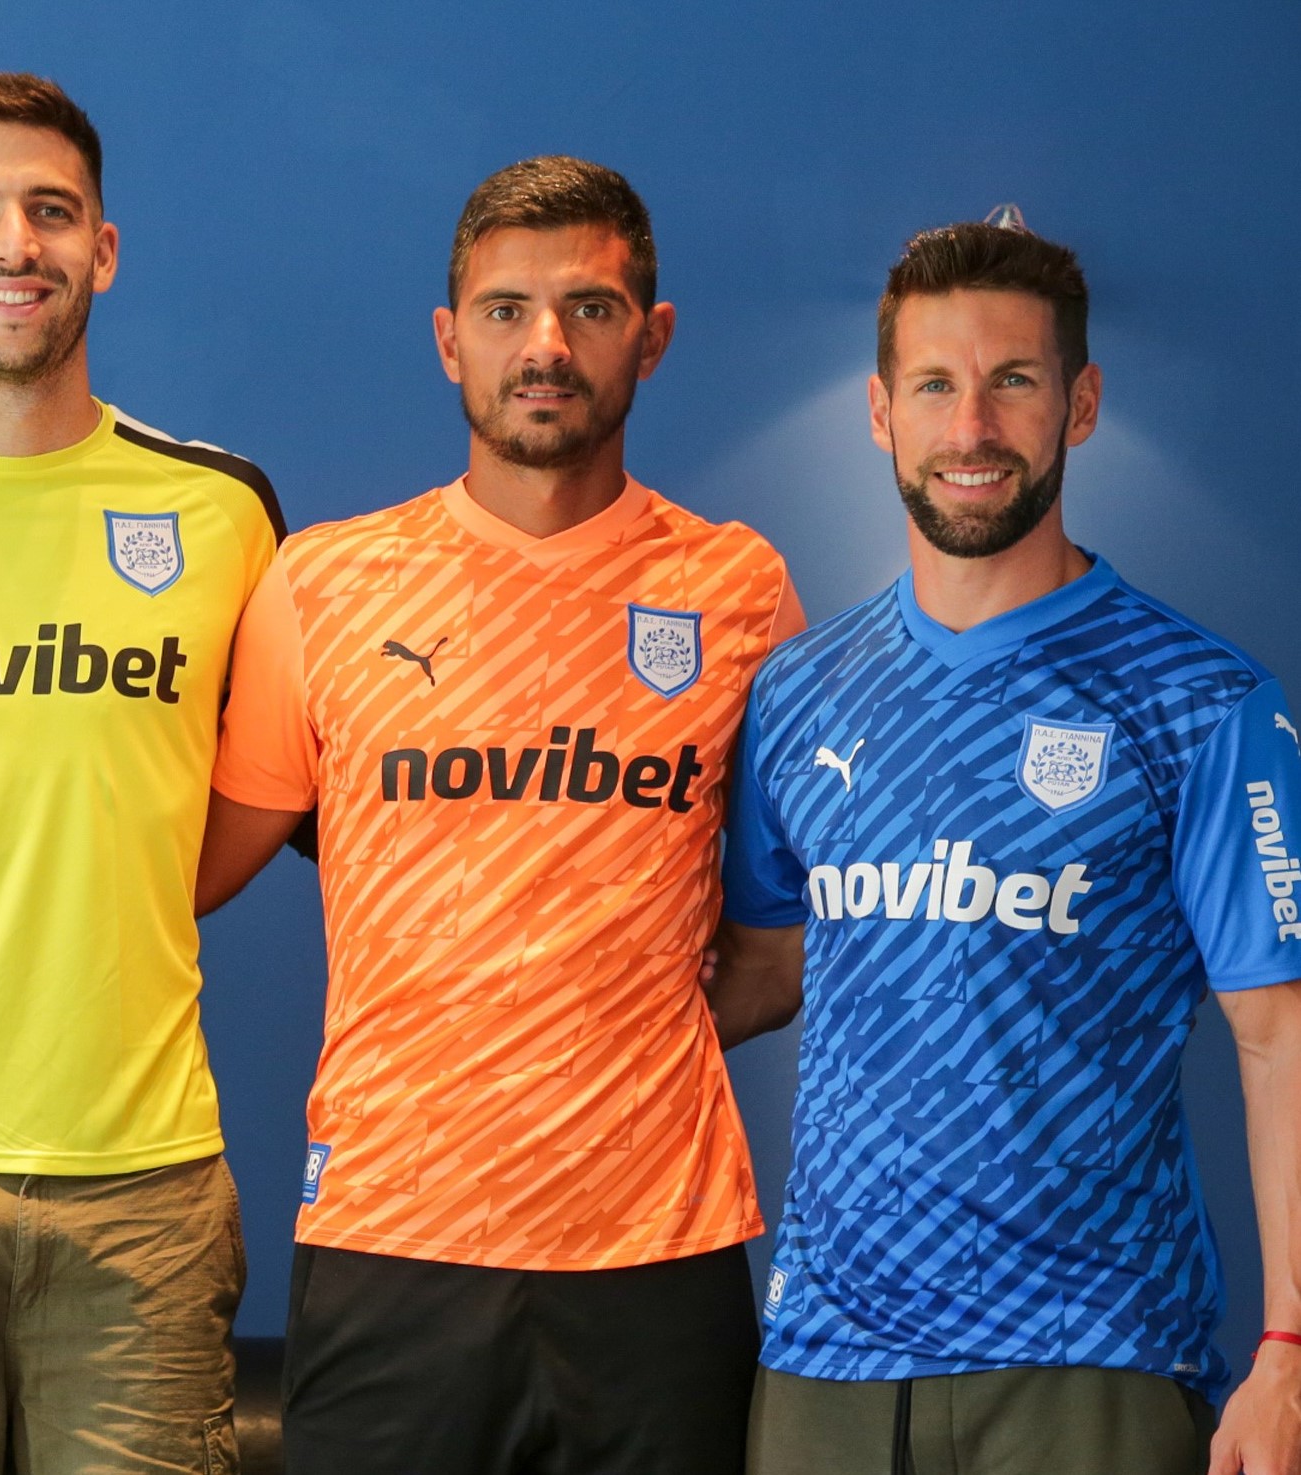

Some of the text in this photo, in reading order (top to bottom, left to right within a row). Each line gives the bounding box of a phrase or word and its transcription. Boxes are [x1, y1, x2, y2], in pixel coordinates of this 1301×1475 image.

[381, 726, 703, 814] novibet
[1060, 732, 1102, 743] ΓΙΑΝΝΙΝΑ
[808, 838, 1093, 935] novibet
